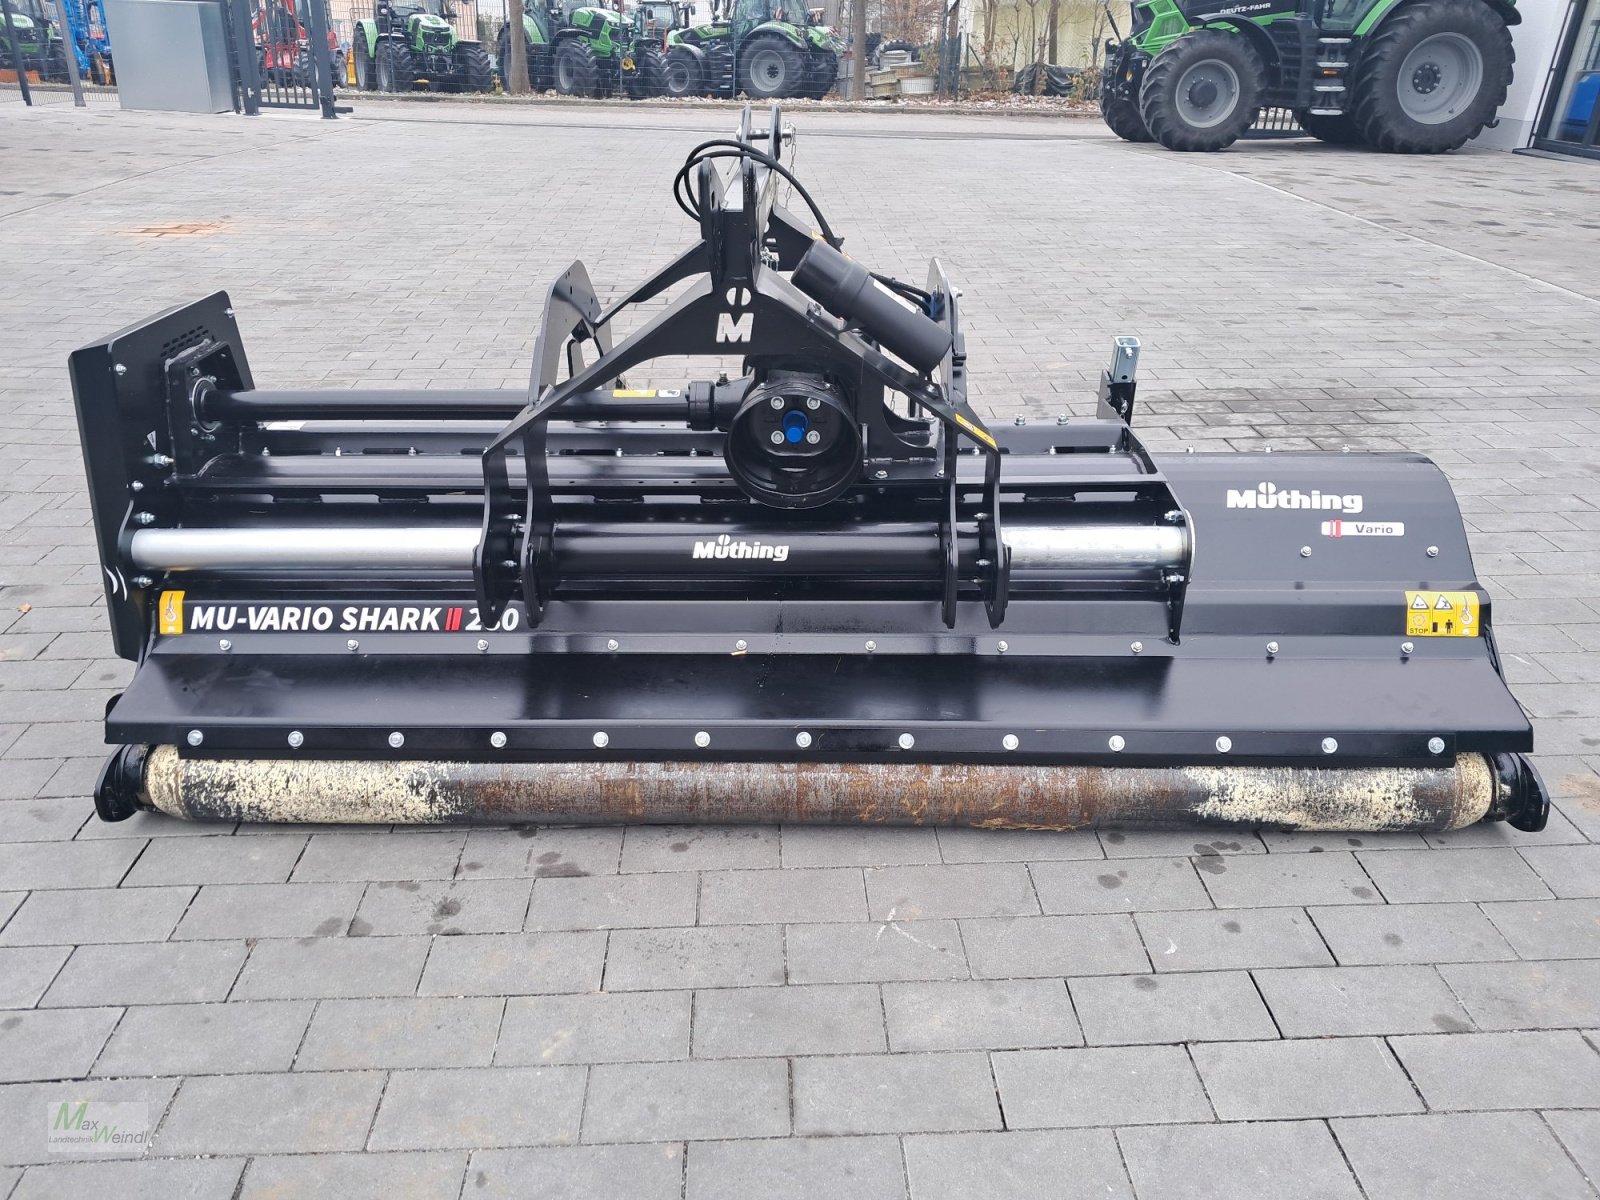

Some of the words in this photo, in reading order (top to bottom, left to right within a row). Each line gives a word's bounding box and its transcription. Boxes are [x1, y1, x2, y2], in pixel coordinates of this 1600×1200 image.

[1220, 2, 1271, 15] DEUTZ-FAHR
[1226, 482, 1364, 513] Müthing
[1355, 524, 1394, 535] Vario
[692, 534, 790, 562] Müthing
[190, 606, 334, 631] MU-VARIO
[339, 606, 443, 631] SHARK
[465, 608, 520, 632] 20
